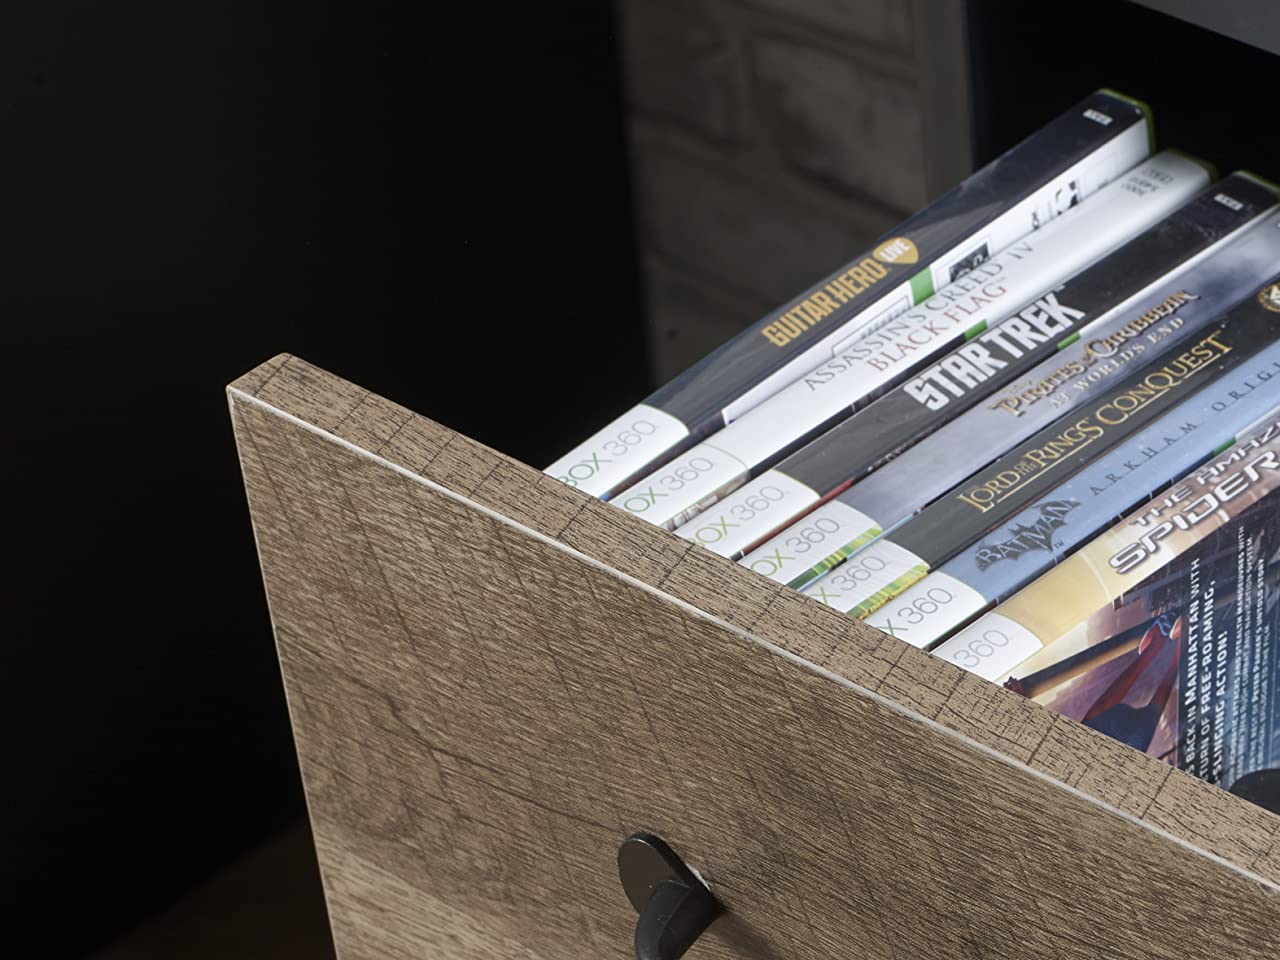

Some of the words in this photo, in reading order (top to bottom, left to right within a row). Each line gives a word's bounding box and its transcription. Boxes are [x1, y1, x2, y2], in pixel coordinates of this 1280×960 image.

[878, 238, 911, 263] LIVE
[925, 260, 1004, 311] CREED
[1007, 241, 1033, 260] IV
[761, 291, 841, 348] GUITAR
[825, 257, 889, 305] HERO
[867, 320, 950, 373] BLACK
[943, 281, 1007, 323] FLAG
[1147, 317, 1184, 343] END
[903, 341, 1009, 411] STAR
[980, 292, 1086, 359] TREK
[988, 360, 1086, 417] PIRATES
[1083, 289, 1201, 358] CARIBBEAN
[958, 470, 1021, 513] LORD
[1026, 418, 1104, 467] RINGS
[1096, 329, 1232, 425] CONQUEST
[557, 451, 613, 489] BOX
[602, 419, 657, 457] 360
[1090, 421, 1199, 496] ARKHAM
[623, 486, 669, 513] OX
[659, 456, 715, 492] 360
[730, 485, 785, 521] 360
[1130, 485, 1194, 528] THE
[750, 548, 797, 577] OX
[785, 517, 840, 554] 360
[976, 499, 1074, 562] BATMAN
[831, 555, 887, 593] 360
[1190, 558, 1200, 600] WITH
[897, 587, 954, 625] 360
[953, 629, 1010, 669] 360
[1184, 600, 1199, 706] MANHATTAN
[1201, 581, 1216, 715] FREE-ROAMING,
[1215, 630, 1228, 697] ACTION!
[1185, 724, 1197, 764] BACK
[1187, 705, 1197, 723] IN
[1201, 717, 1211, 736] OF
